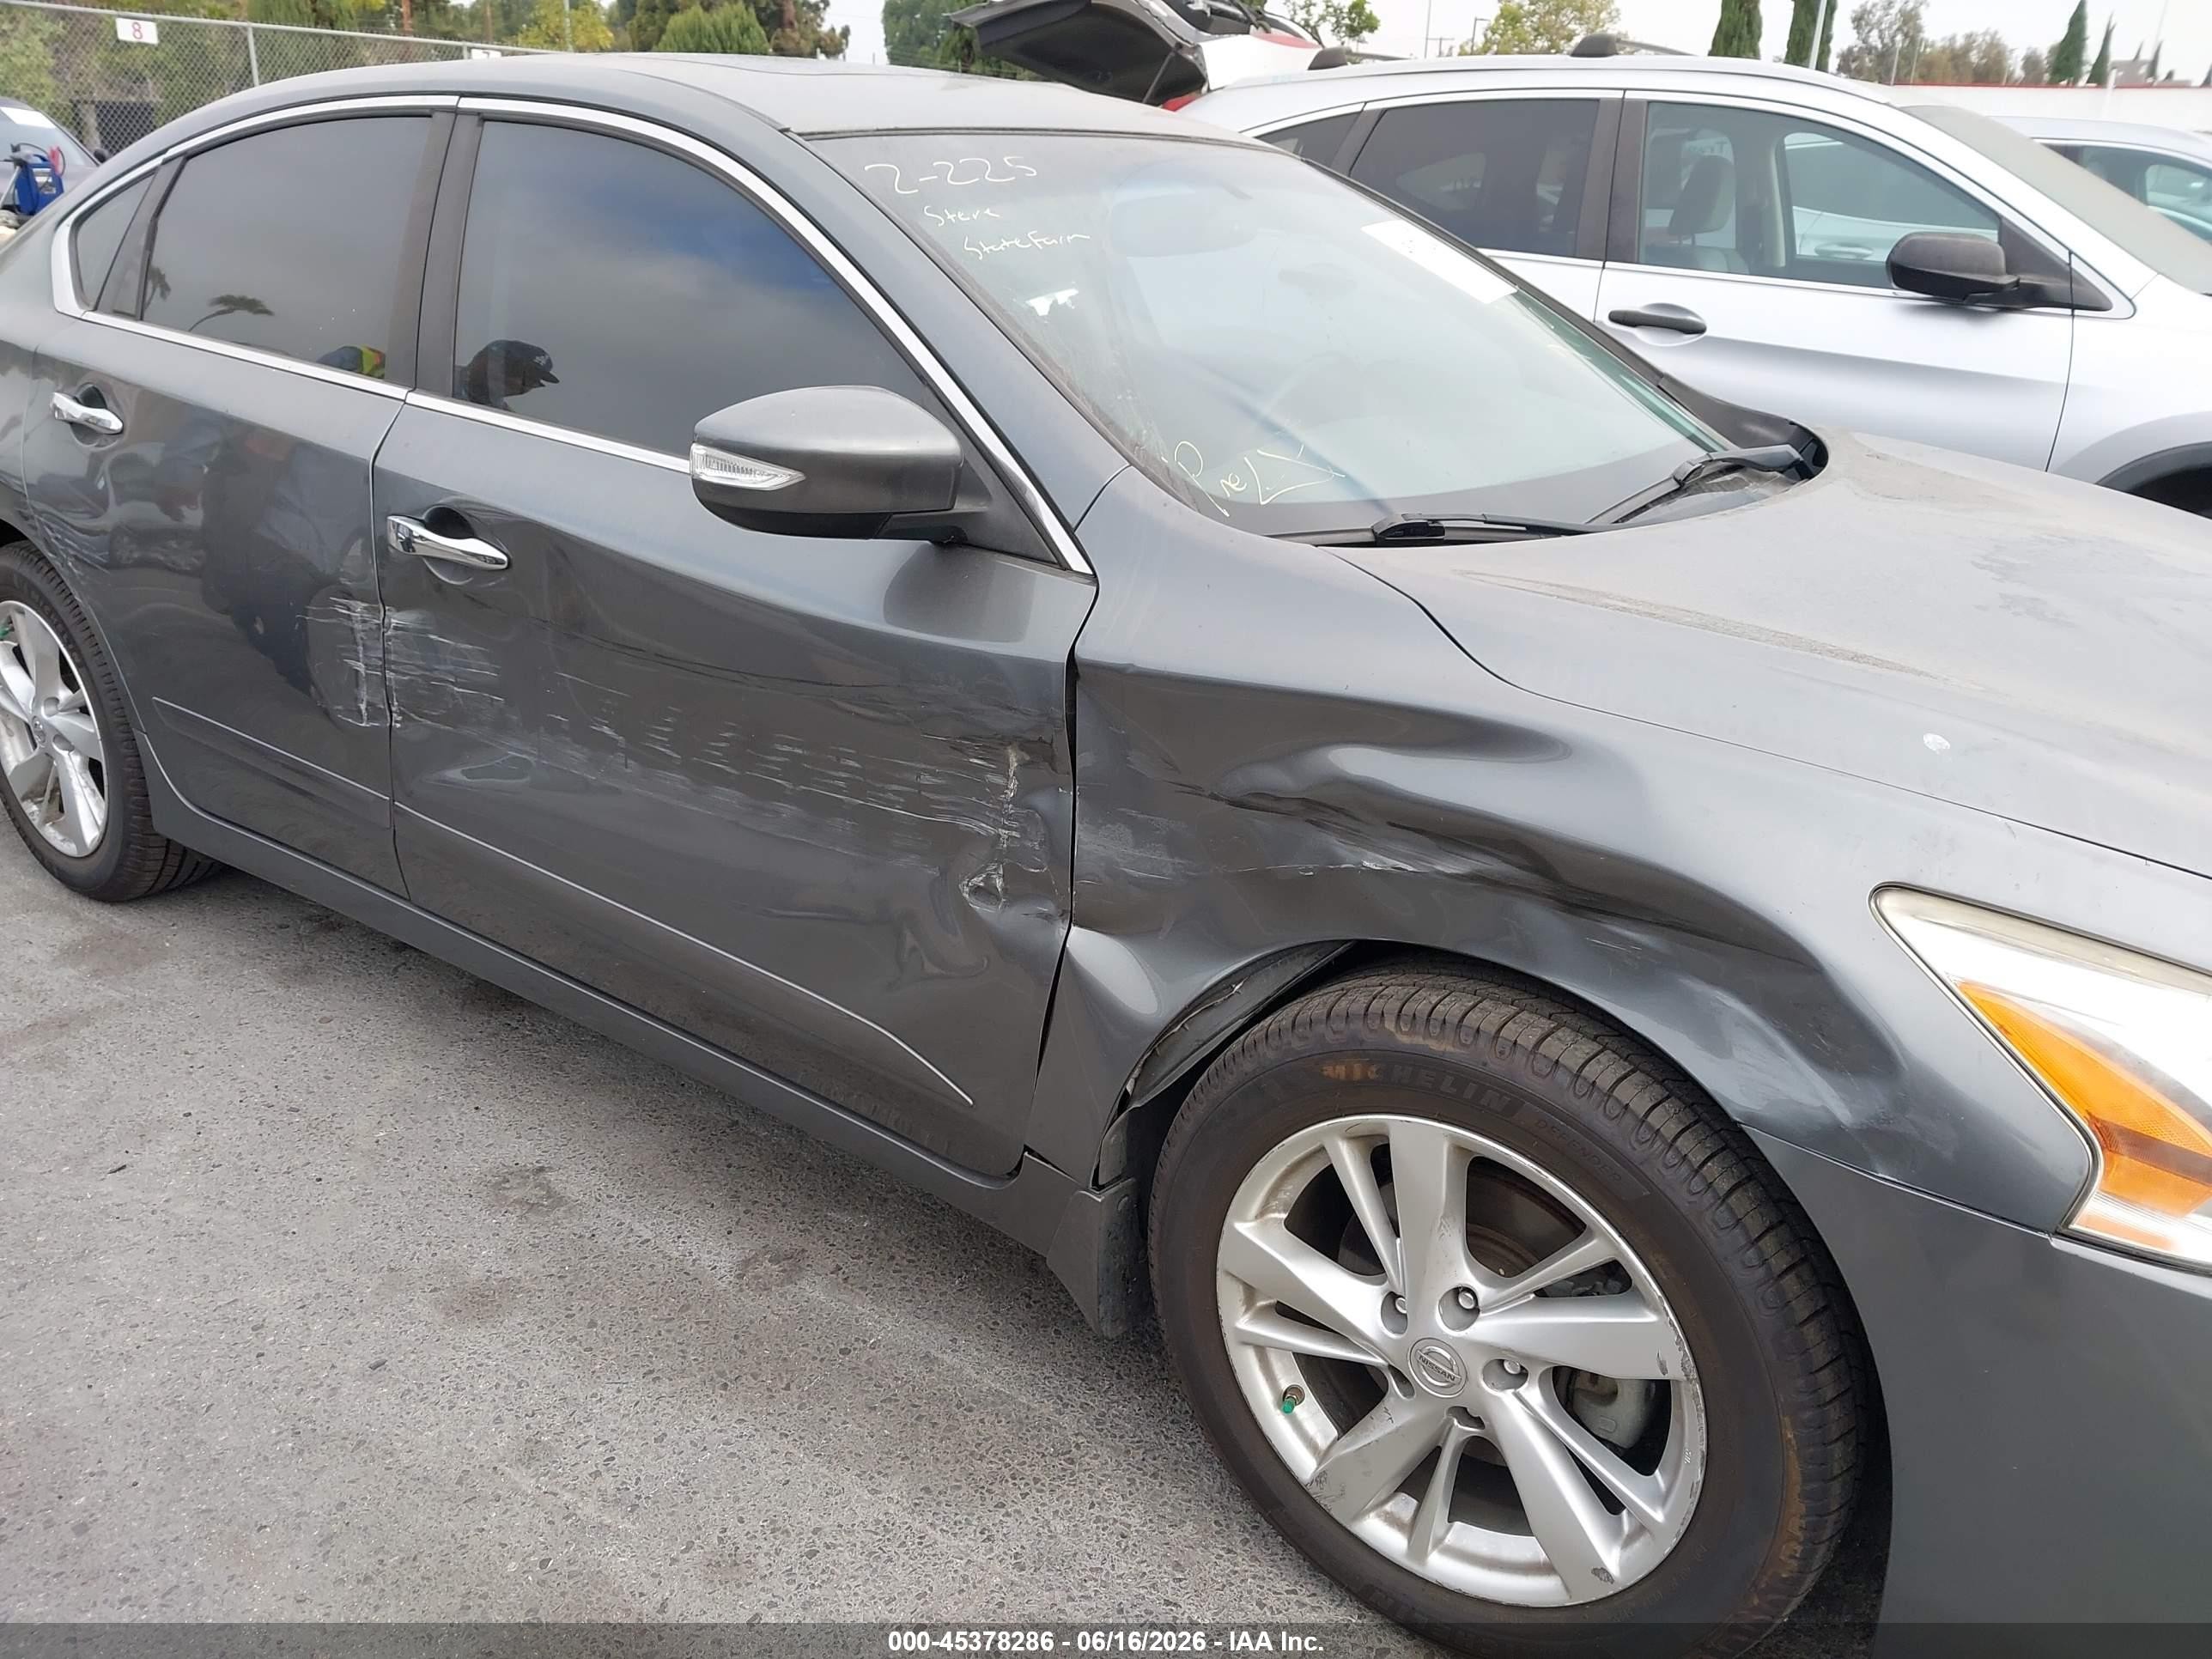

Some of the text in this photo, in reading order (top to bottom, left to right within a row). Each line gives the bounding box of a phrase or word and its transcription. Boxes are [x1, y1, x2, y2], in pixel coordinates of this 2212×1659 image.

[131, 21, 143, 40] 8
[864, 156, 1037, 194] 2-225
[1322, 1062, 1512, 1114] MICHELIN
[1418, 1355, 1456, 1382] NISSAN
